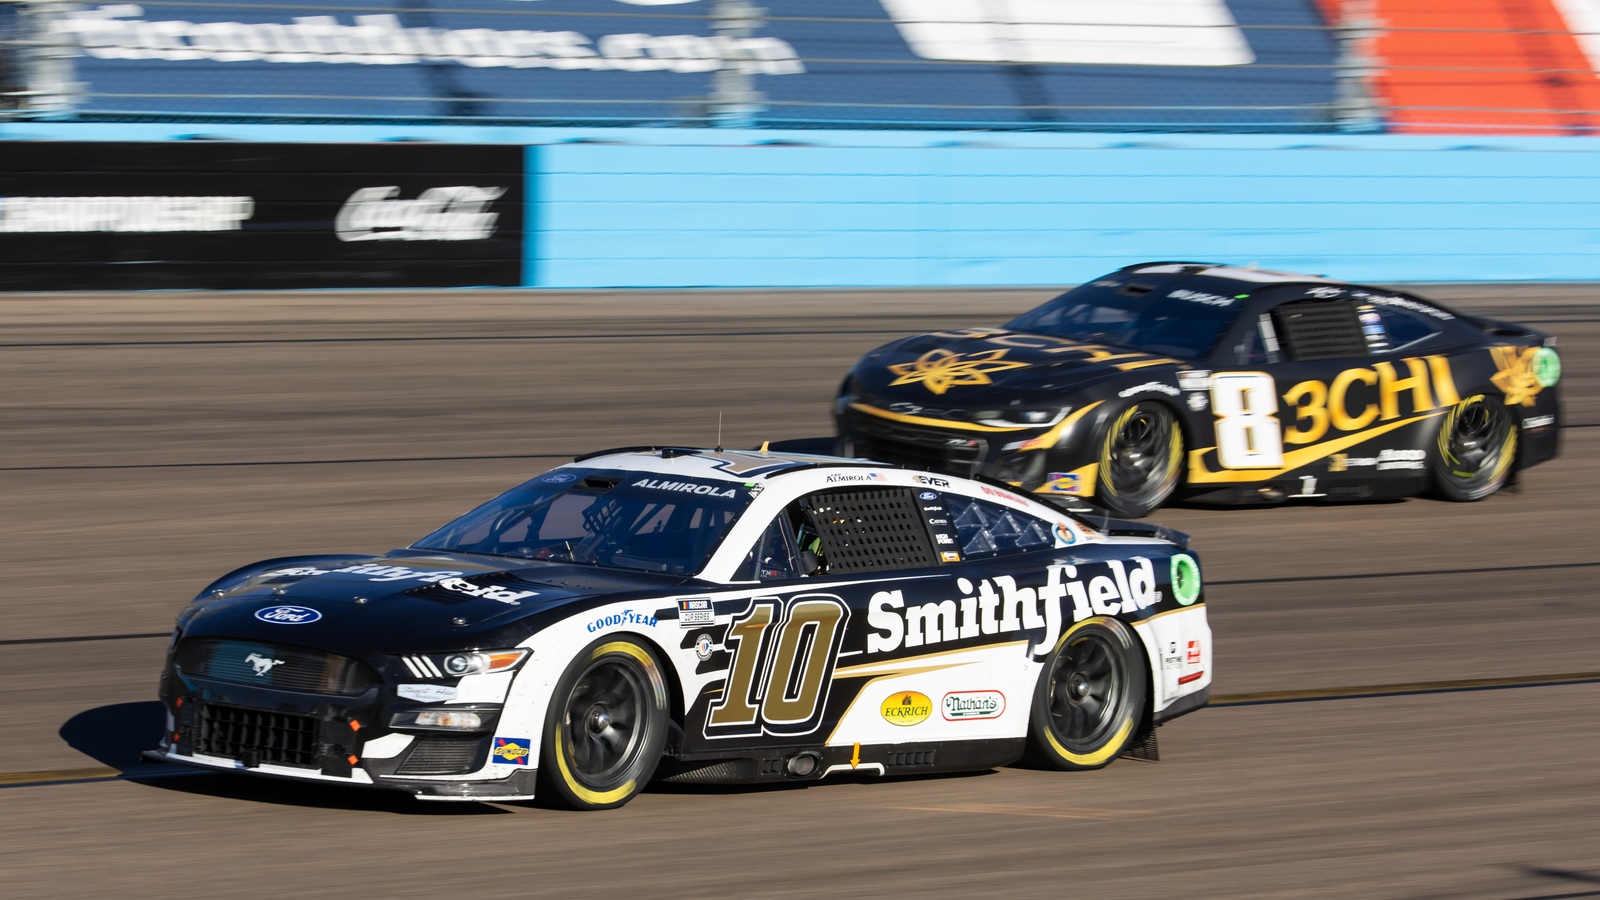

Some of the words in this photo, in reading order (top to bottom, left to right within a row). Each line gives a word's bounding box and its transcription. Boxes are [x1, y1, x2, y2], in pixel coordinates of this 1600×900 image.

[1282, 354, 1461, 445] 3CHI
[1211, 371, 1285, 469] 8
[631, 478, 738, 499] ALMIROLA
[826, 475, 872, 483] ALMIROLA
[264, 605, 311, 622] Ford
[866, 557, 1157, 657] Smithfield
[703, 594, 851, 738] 10
[885, 706, 929, 718] ECKRICH
[946, 696, 999, 712] Nathan's
